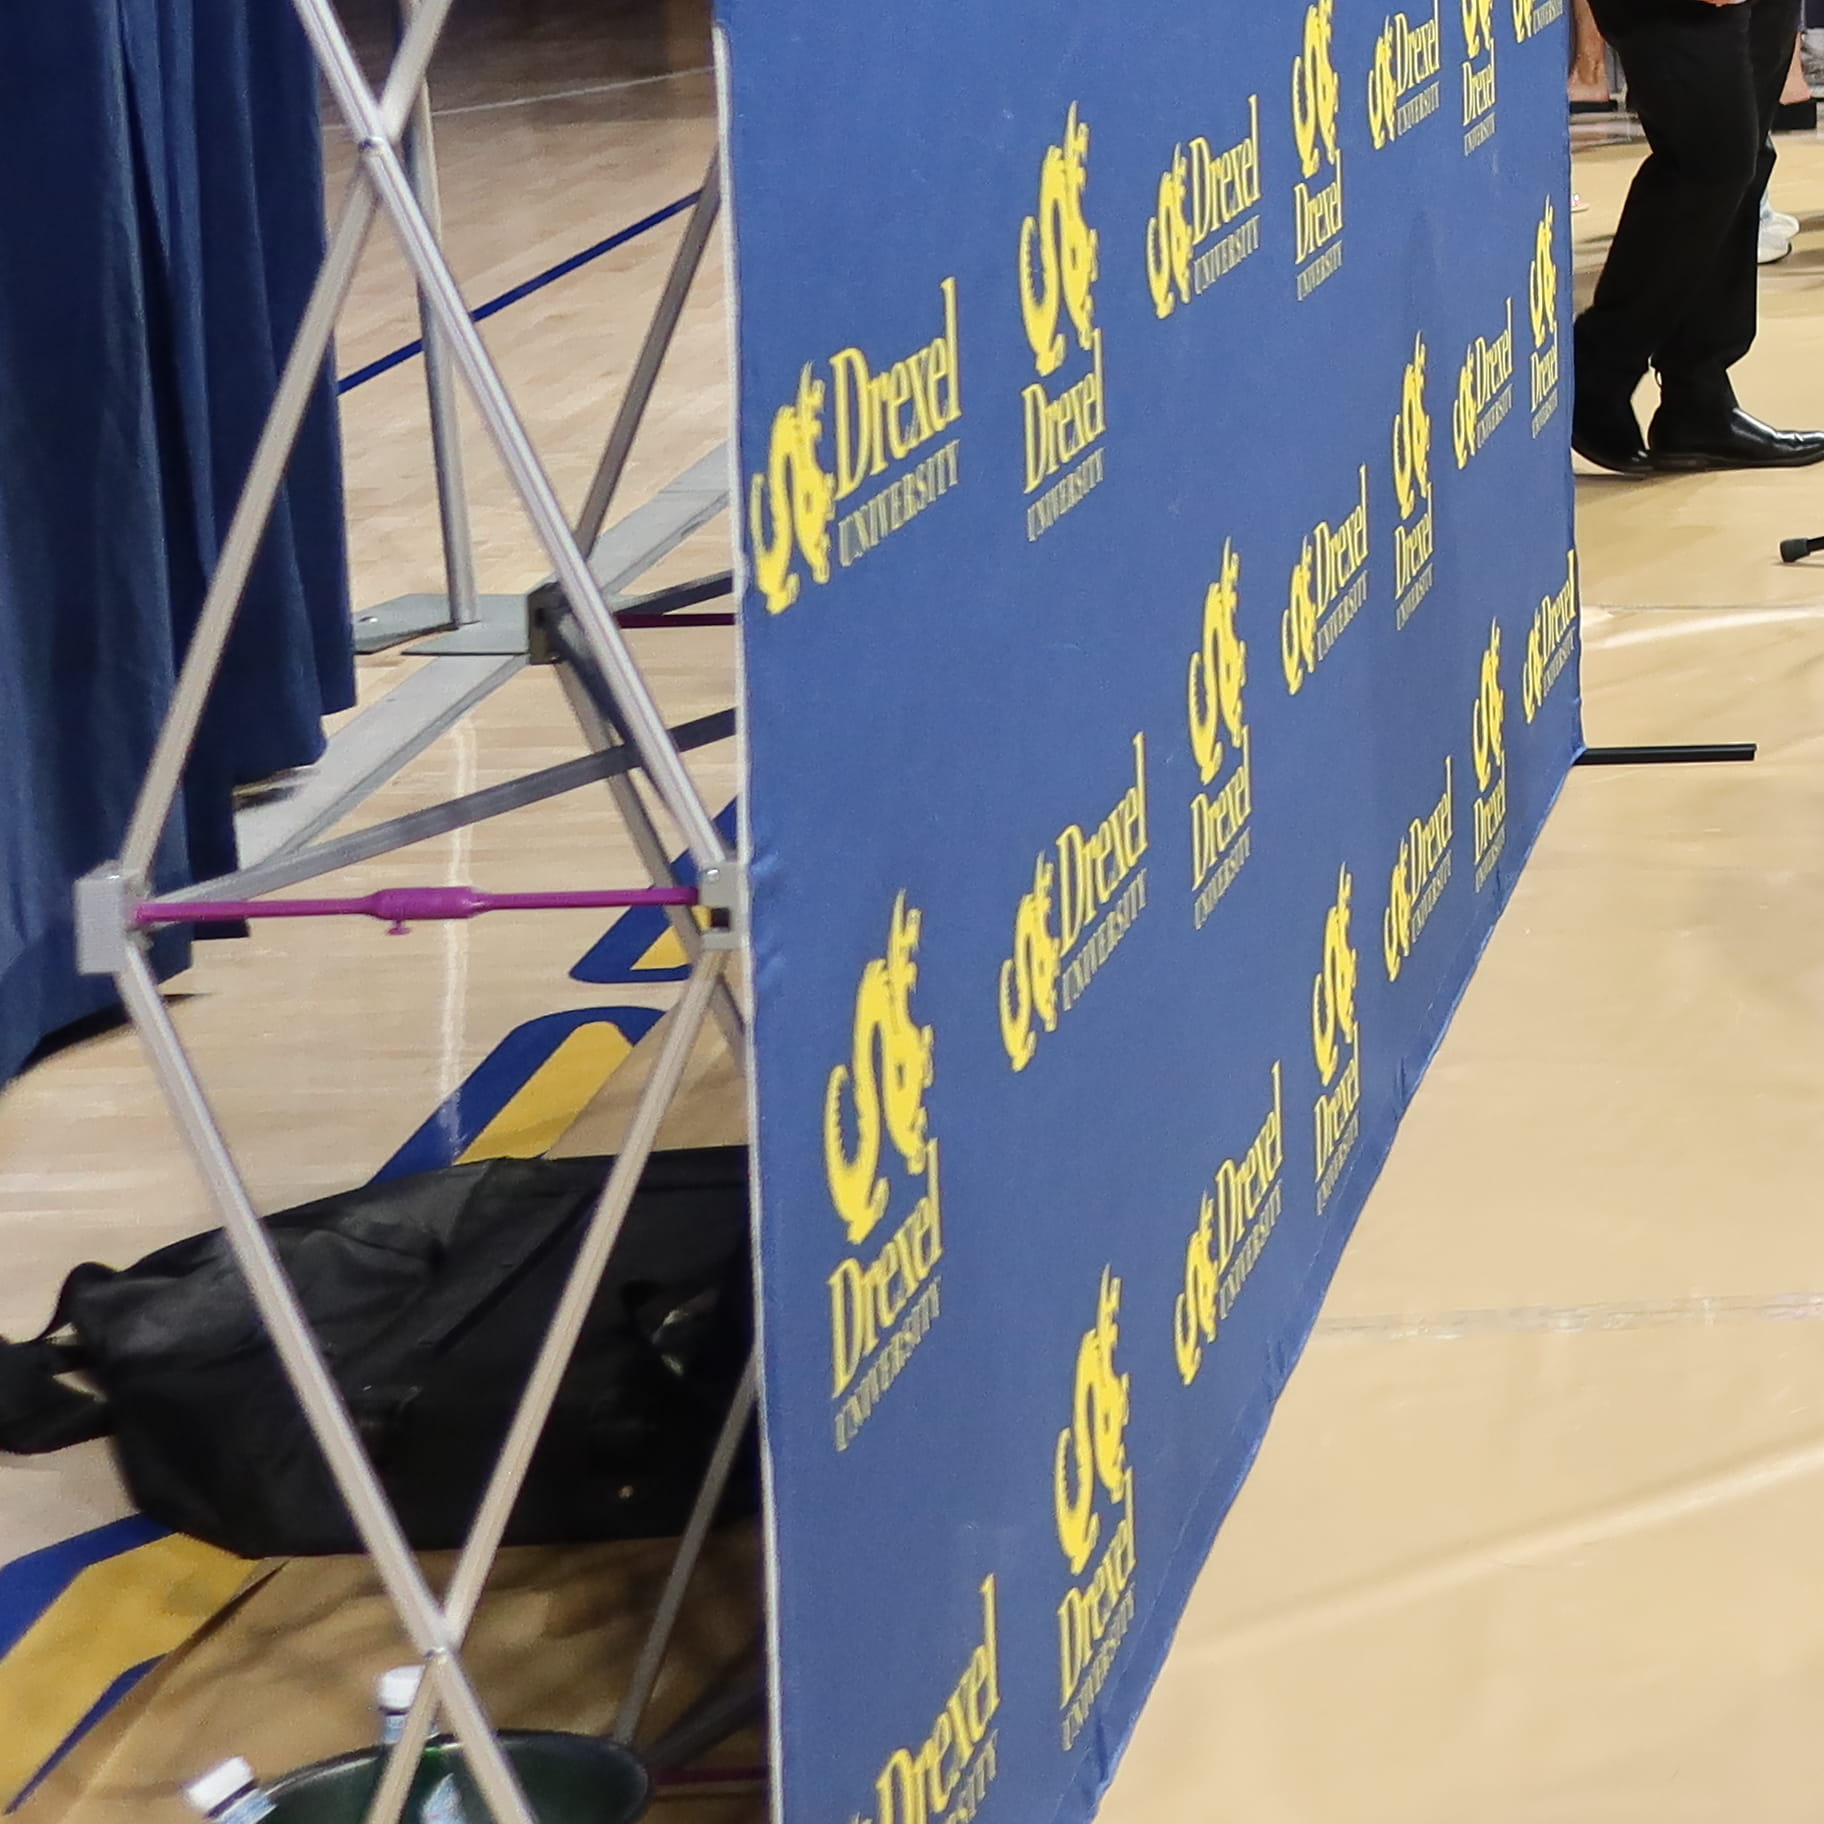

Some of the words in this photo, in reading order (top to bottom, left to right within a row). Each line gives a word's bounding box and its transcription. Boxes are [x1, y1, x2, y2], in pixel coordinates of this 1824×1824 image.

[1462, 38, 1495, 126] Drexel
[1189, 94, 1263, 244] Drexel
[1294, 149, 1343, 264] Drexel
[1194, 214, 1260, 295] UNIVERSITY
[1297, 239, 1343, 301] UNIVERSITY
[829, 276, 961, 500] Drexel
[1021, 328, 1106, 493] Drexel
[1474, 296, 1512, 413] Drexel
[1530, 320, 1558, 413] Drexel
[839, 439, 960, 566] UNIVERSITY
[1027, 447, 1104, 541] UNIVERSITY
[1313, 464, 1369, 617] Drexel
[1394, 482, 1434, 599] Drexel
[1317, 569, 1367, 661] UNIVERSITY
[1542, 549, 1575, 661] Drexel
[1056, 731, 1148, 957] Drexel
[1190, 724, 1252, 892] Drexel
[1195, 827, 1251, 929] UNIVERSITY
[1409, 755, 1453, 898] Drexel
[1473, 749, 1505, 866] Drexel
[1062, 868, 1148, 1011] UNIVERSITY
[1216, 1059, 1284, 1276] Drexel
[1314, 1021, 1360, 1182] Drexel
[827, 1138, 943, 1398] Drexel
[1218, 1178, 1282, 1319] UNIVERSITY
[833, 1276, 942, 1452] UNIVERSITY
[1058, 1466, 1137, 1709] Drexel
[1062, 1582, 1135, 1750] UNIVERSITY
